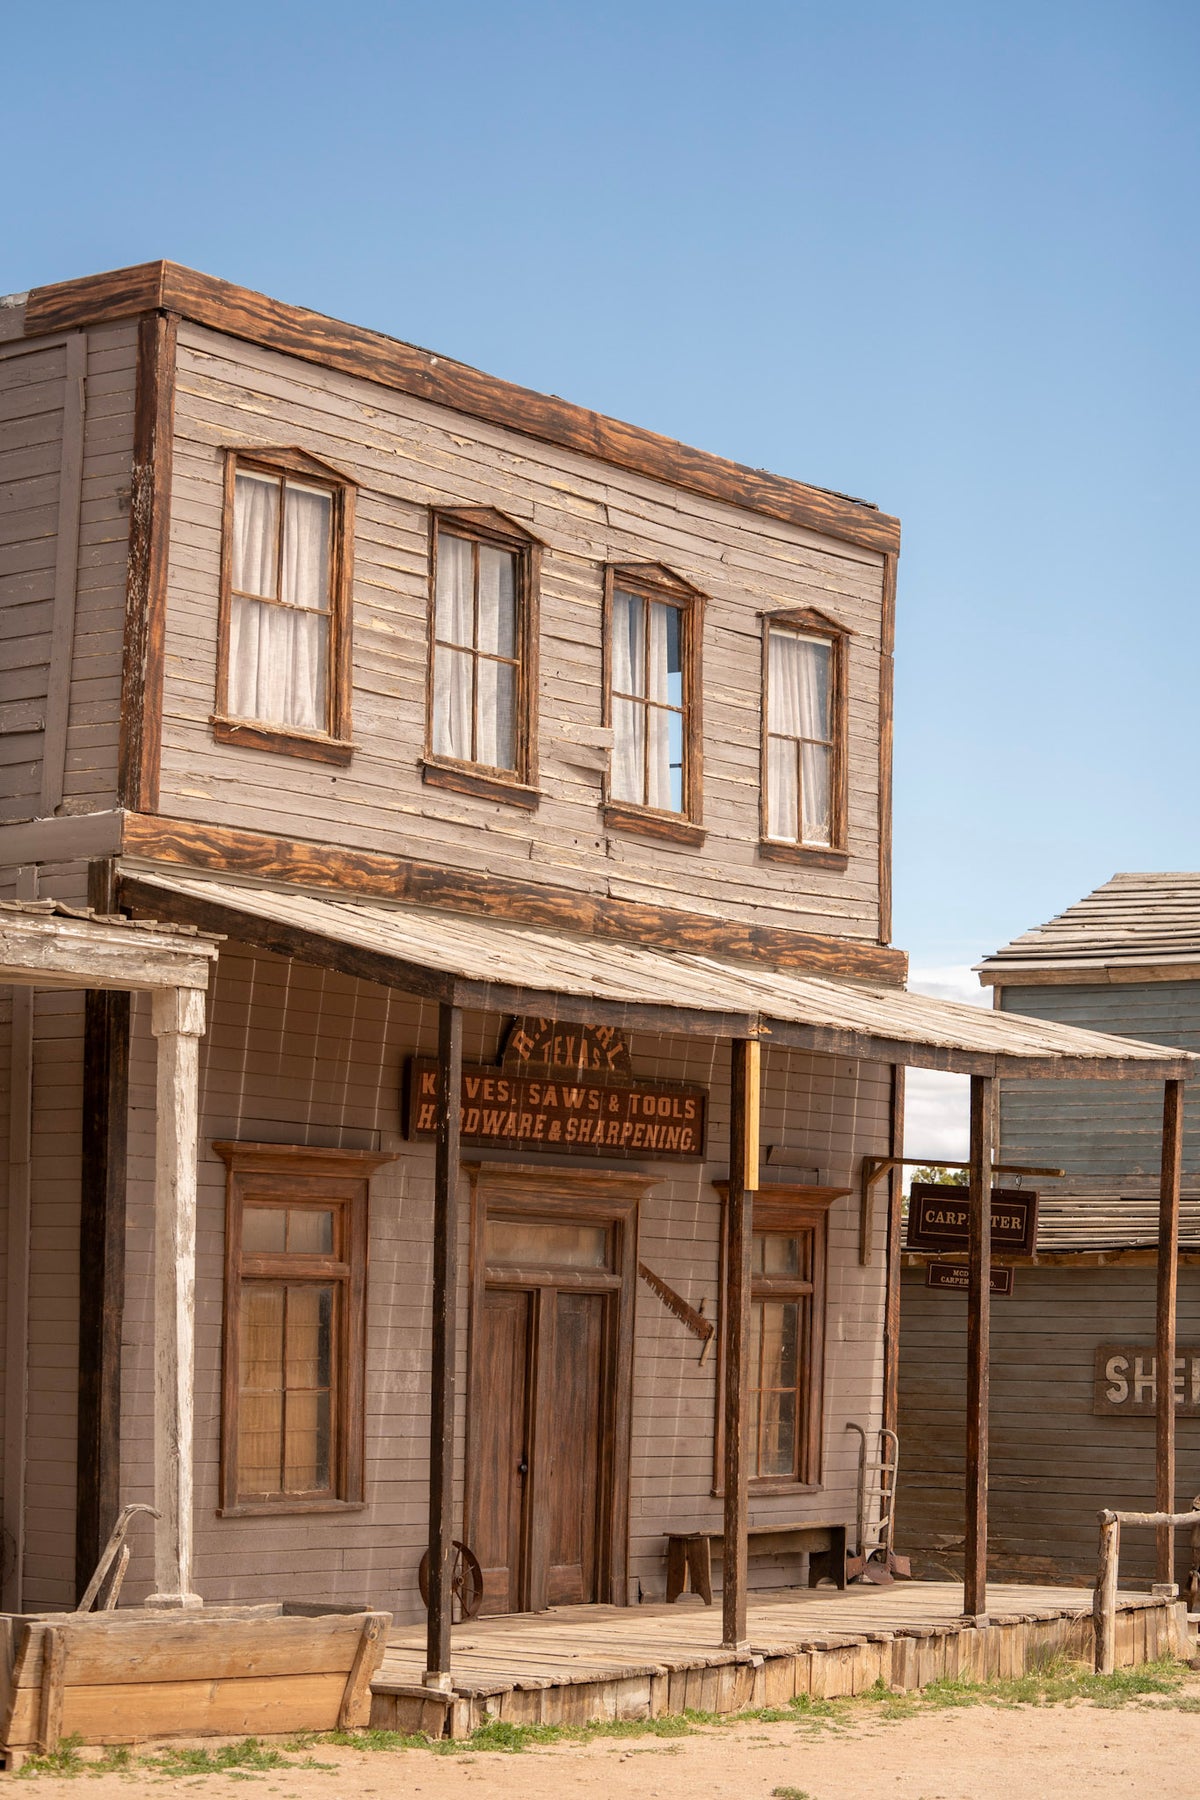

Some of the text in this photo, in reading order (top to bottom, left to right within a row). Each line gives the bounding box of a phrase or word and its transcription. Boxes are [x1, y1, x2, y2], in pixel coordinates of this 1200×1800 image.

[541, 1035, 601, 1071] TEXAS
[529, 1083, 600, 1110] SAWS
[608, 1094, 620, 1113] &
[629, 1093, 696, 1119] TOOLS
[417, 1103, 548, 1140] HDWARE
[547, 1119, 562, 1142] &
[925, 1209, 1022, 1230] CARPTER
